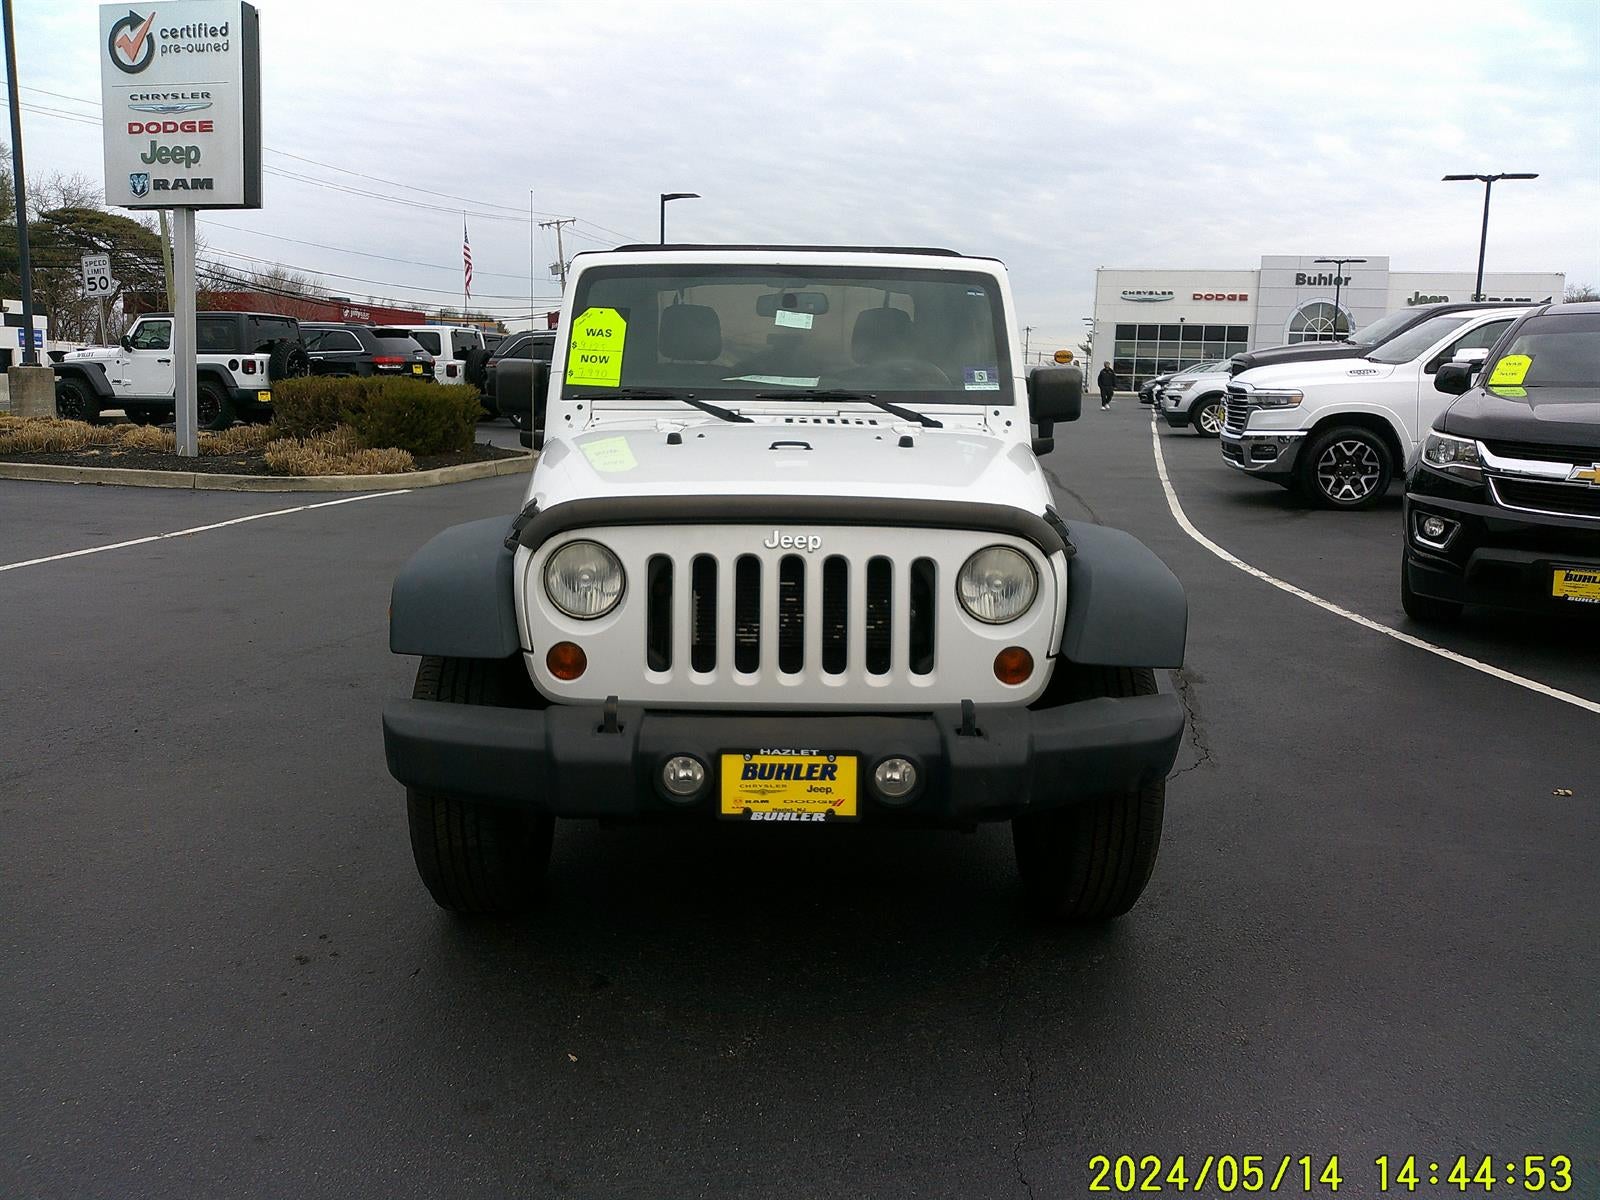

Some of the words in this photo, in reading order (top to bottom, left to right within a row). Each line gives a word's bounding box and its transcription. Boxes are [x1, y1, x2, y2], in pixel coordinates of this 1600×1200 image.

[160, 22, 229, 39] certified
[161, 40, 229, 56] pre-owned
[129, 91, 211, 101] CHRYSLER
[127, 120, 214, 134] DODGE
[140, 140, 201, 168] Jeep
[153, 178, 214, 190] RAM
[87, 276, 109, 291] 50
[1192, 293, 1249, 301] DODGE
[586, 328, 612, 337] WAS
[571, 341, 577, 350] $
[580, 354, 610, 364] NOW
[568, 369, 574, 377] $
[764, 530, 822, 553] Jeep
[760, 748, 819, 756] HAZLET
[741, 762, 838, 780] BUHLER
[806, 785, 833, 794] Jeep
[750, 812, 826, 821] BUHLER
